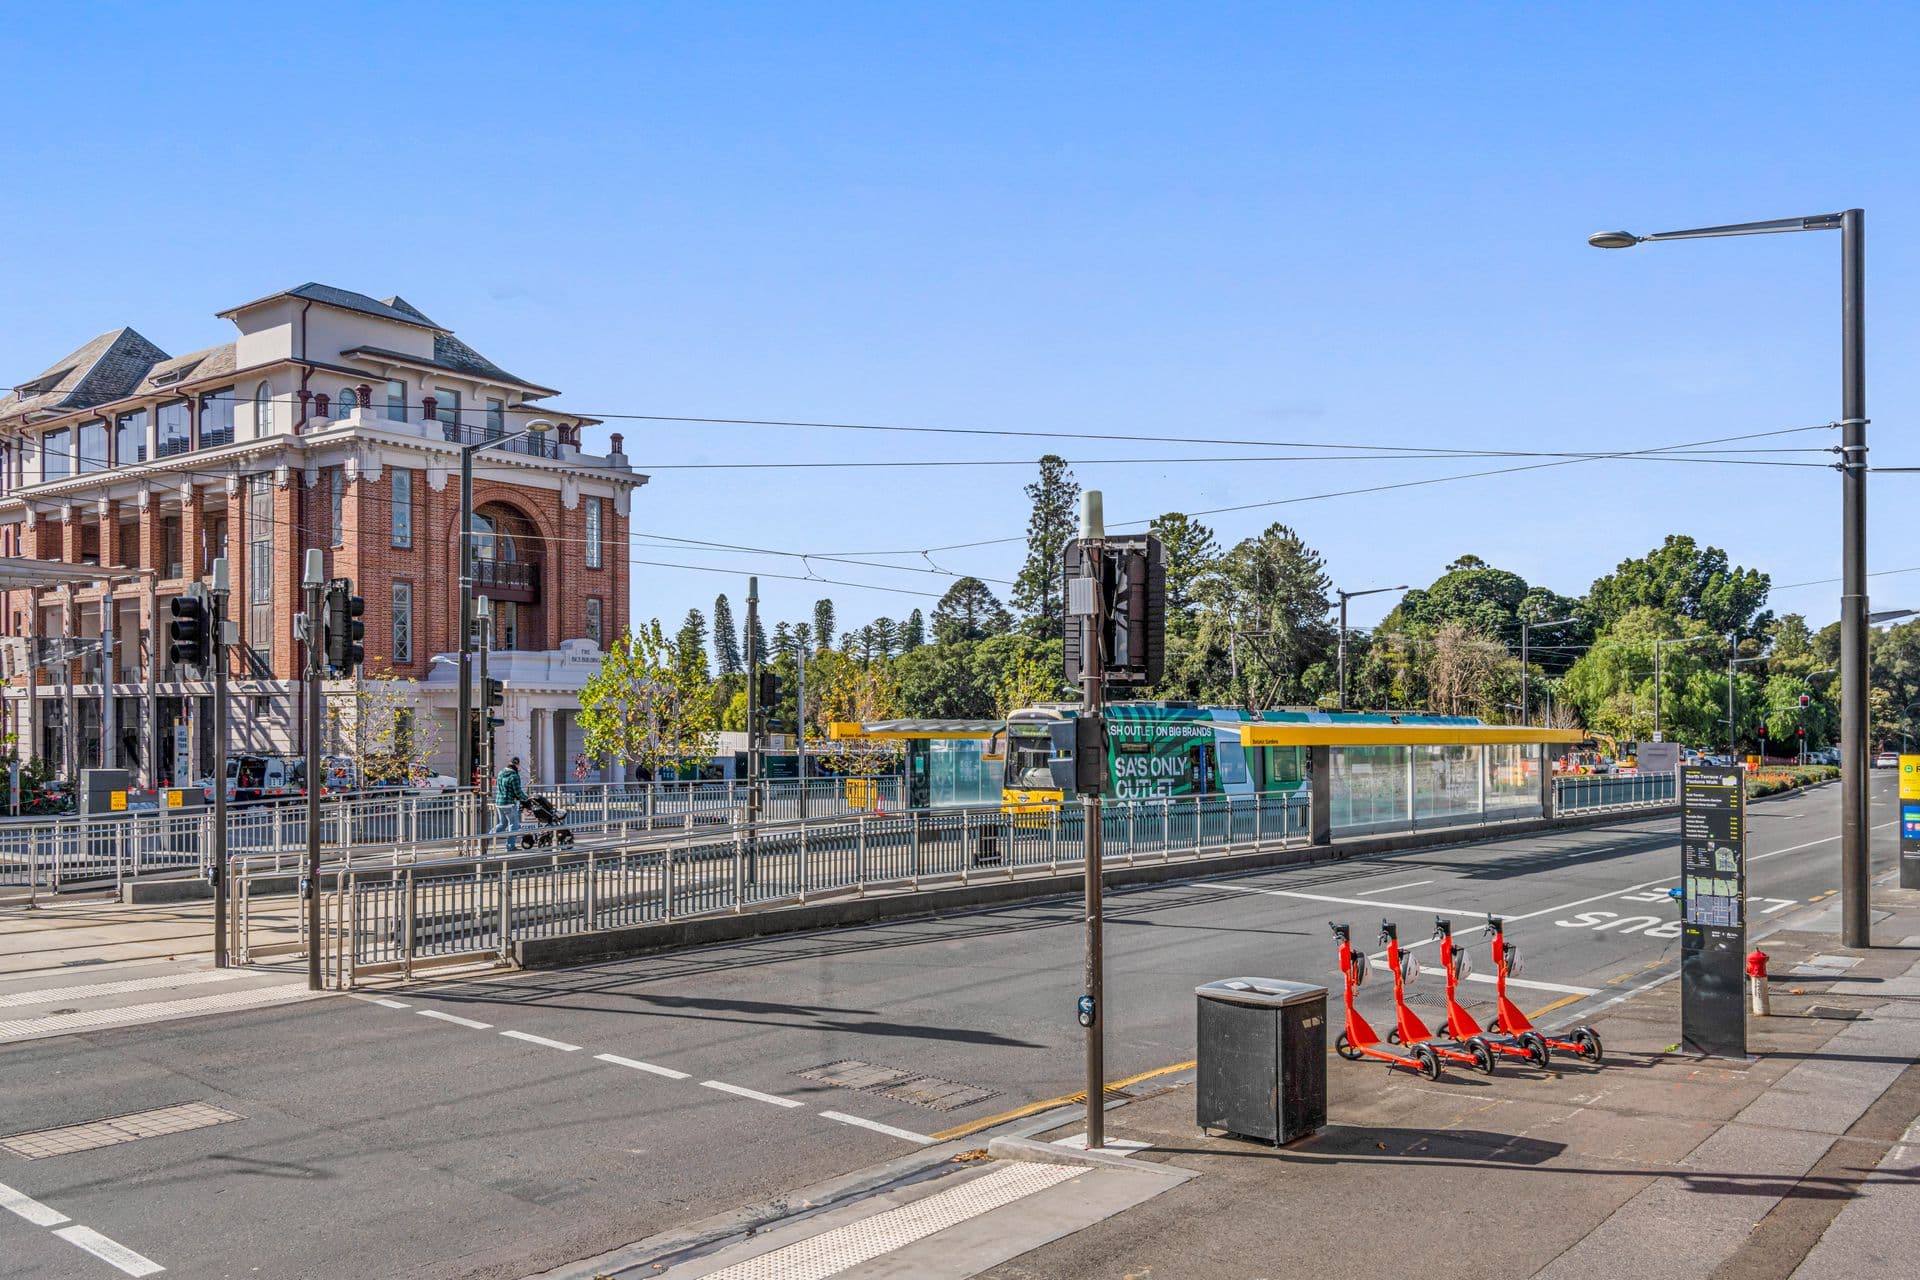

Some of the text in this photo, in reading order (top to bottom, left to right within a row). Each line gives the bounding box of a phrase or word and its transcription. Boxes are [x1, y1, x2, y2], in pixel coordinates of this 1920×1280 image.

[1124, 725, 1154, 736] OUTLET
[1156, 726, 1168, 736] ON
[1169, 726, 1181, 736] BIG
[1182, 726, 1212, 737] BRANDS
[1115, 757, 1188, 777] SA'S ONLY
[1115, 779, 1175, 799] OUTLET
[1555, 911, 1681, 938] BUS
